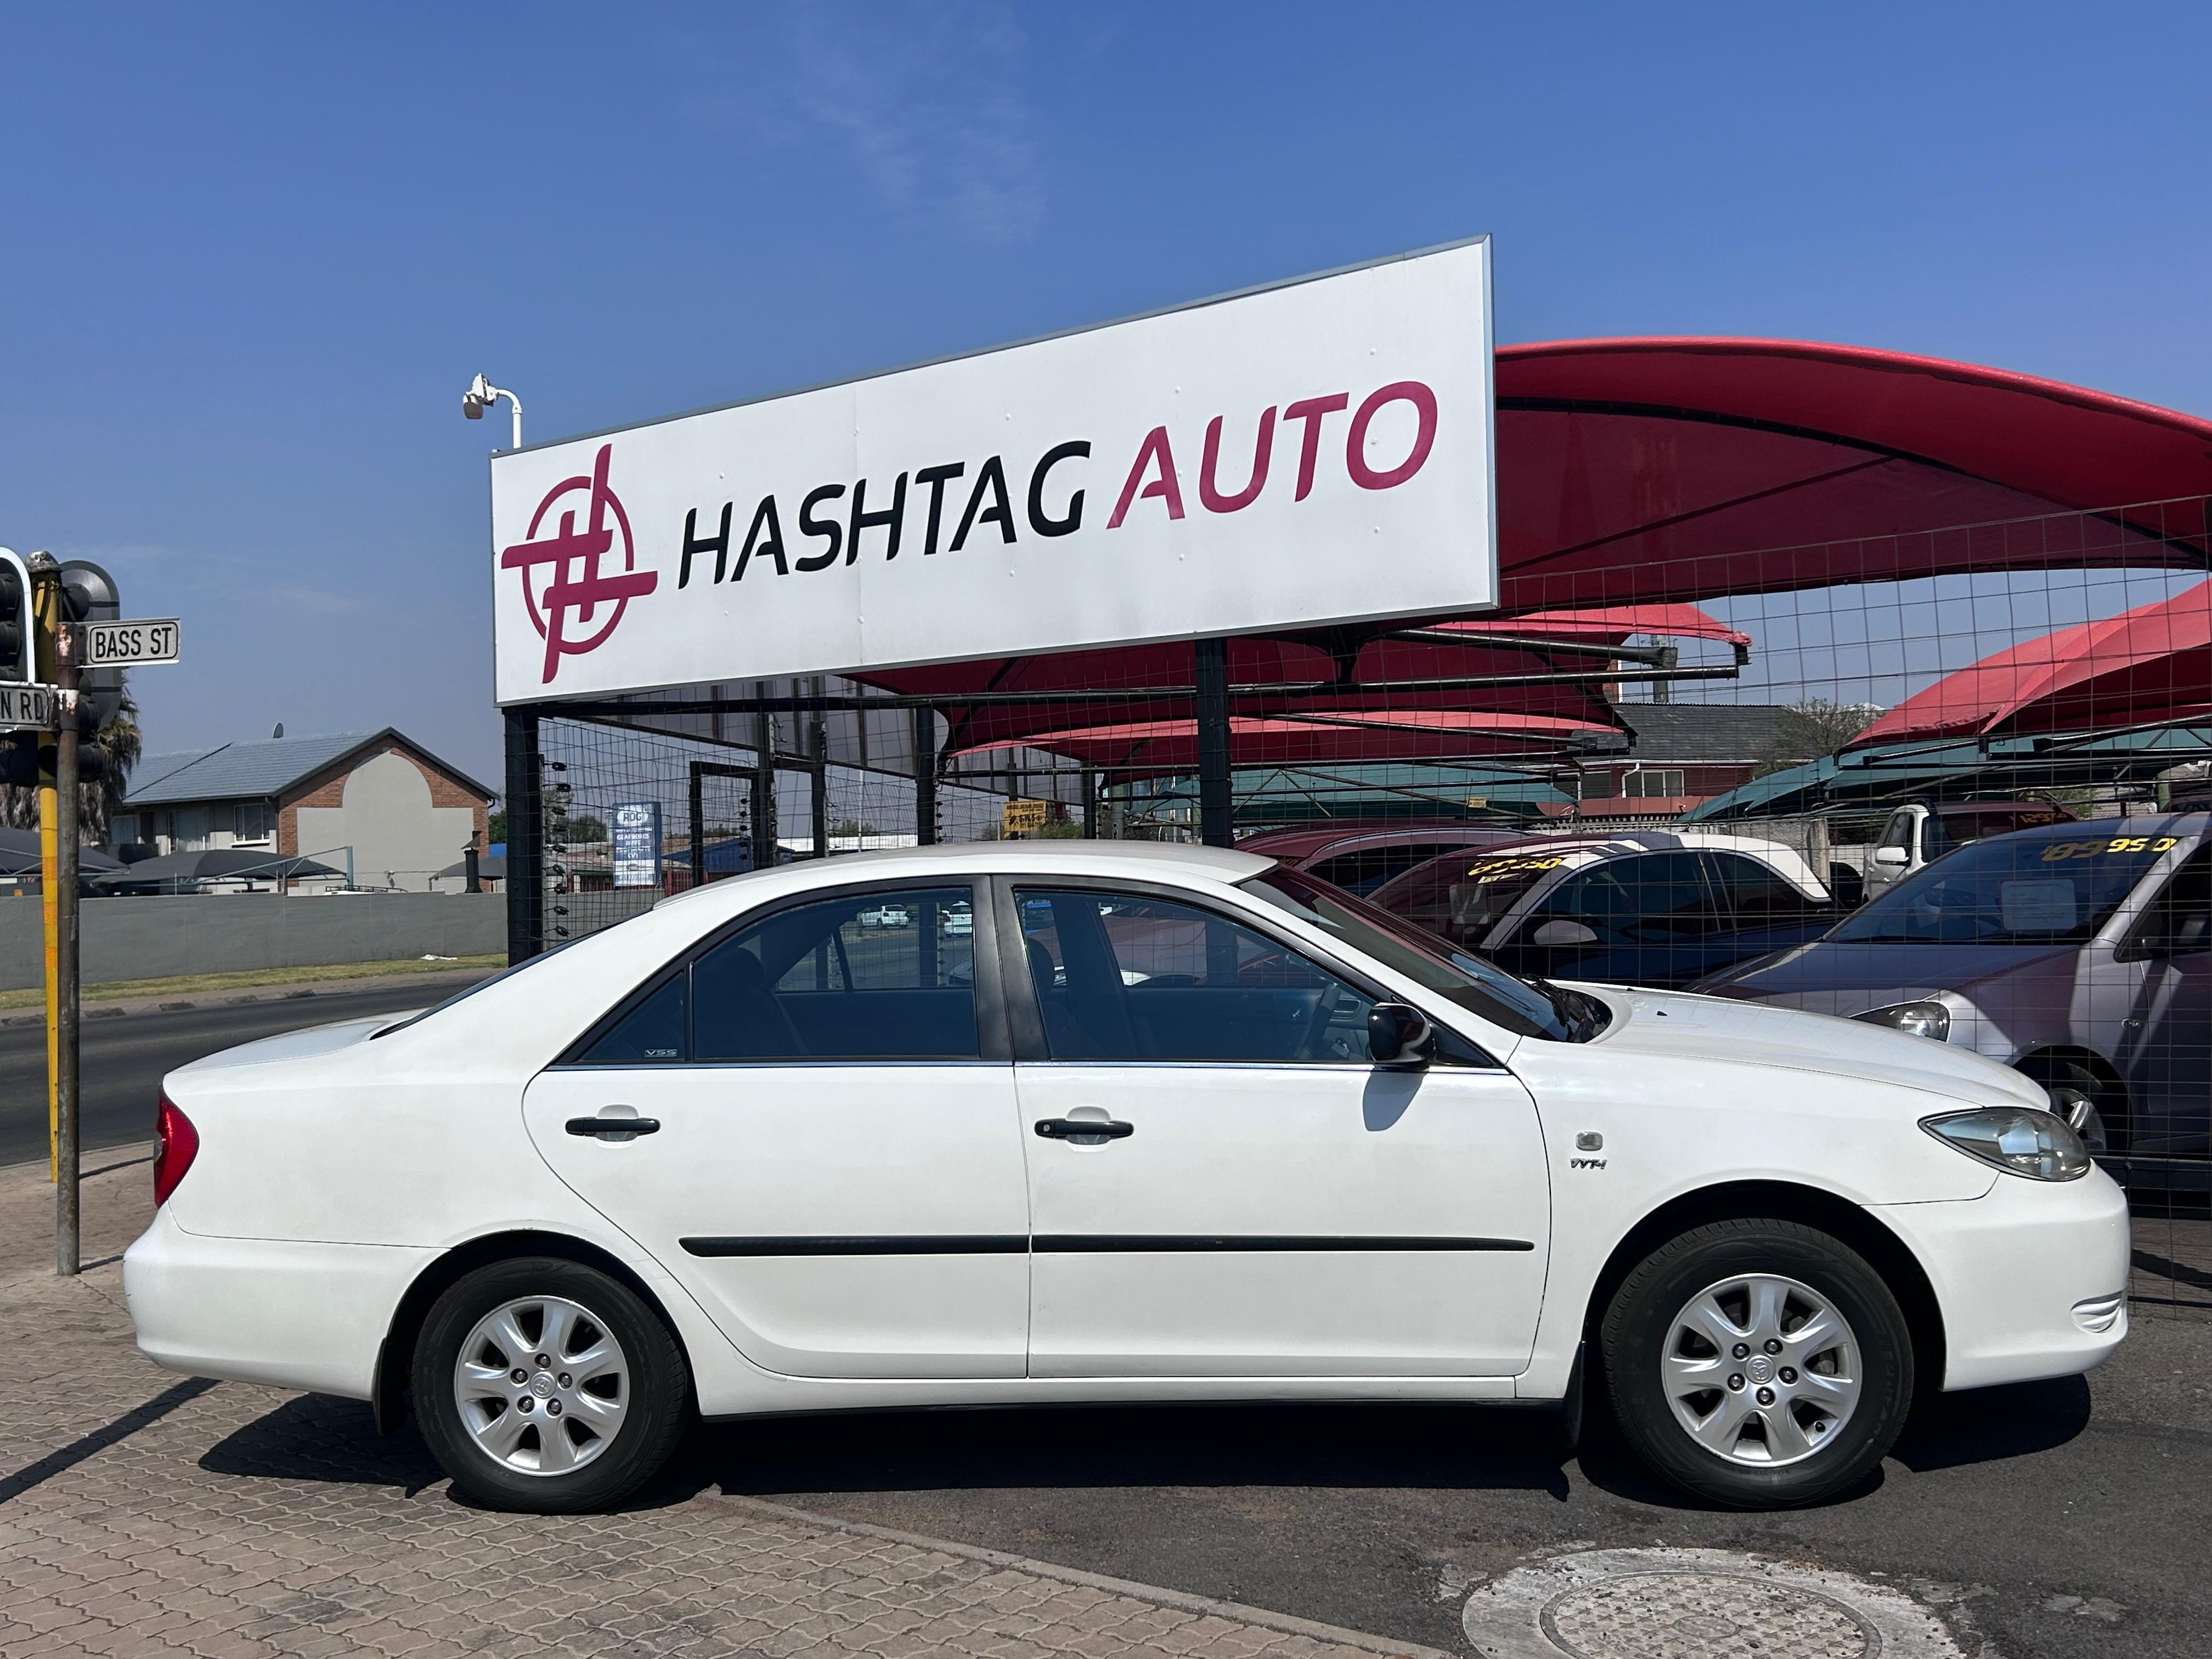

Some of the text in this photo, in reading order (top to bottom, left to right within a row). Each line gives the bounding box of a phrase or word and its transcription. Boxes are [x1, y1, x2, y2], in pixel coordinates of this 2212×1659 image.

[679, 381, 1438, 590] HASHTAG AUTO
[95, 627, 172, 658] BASS ST
[20, 692, 44, 720] RD
